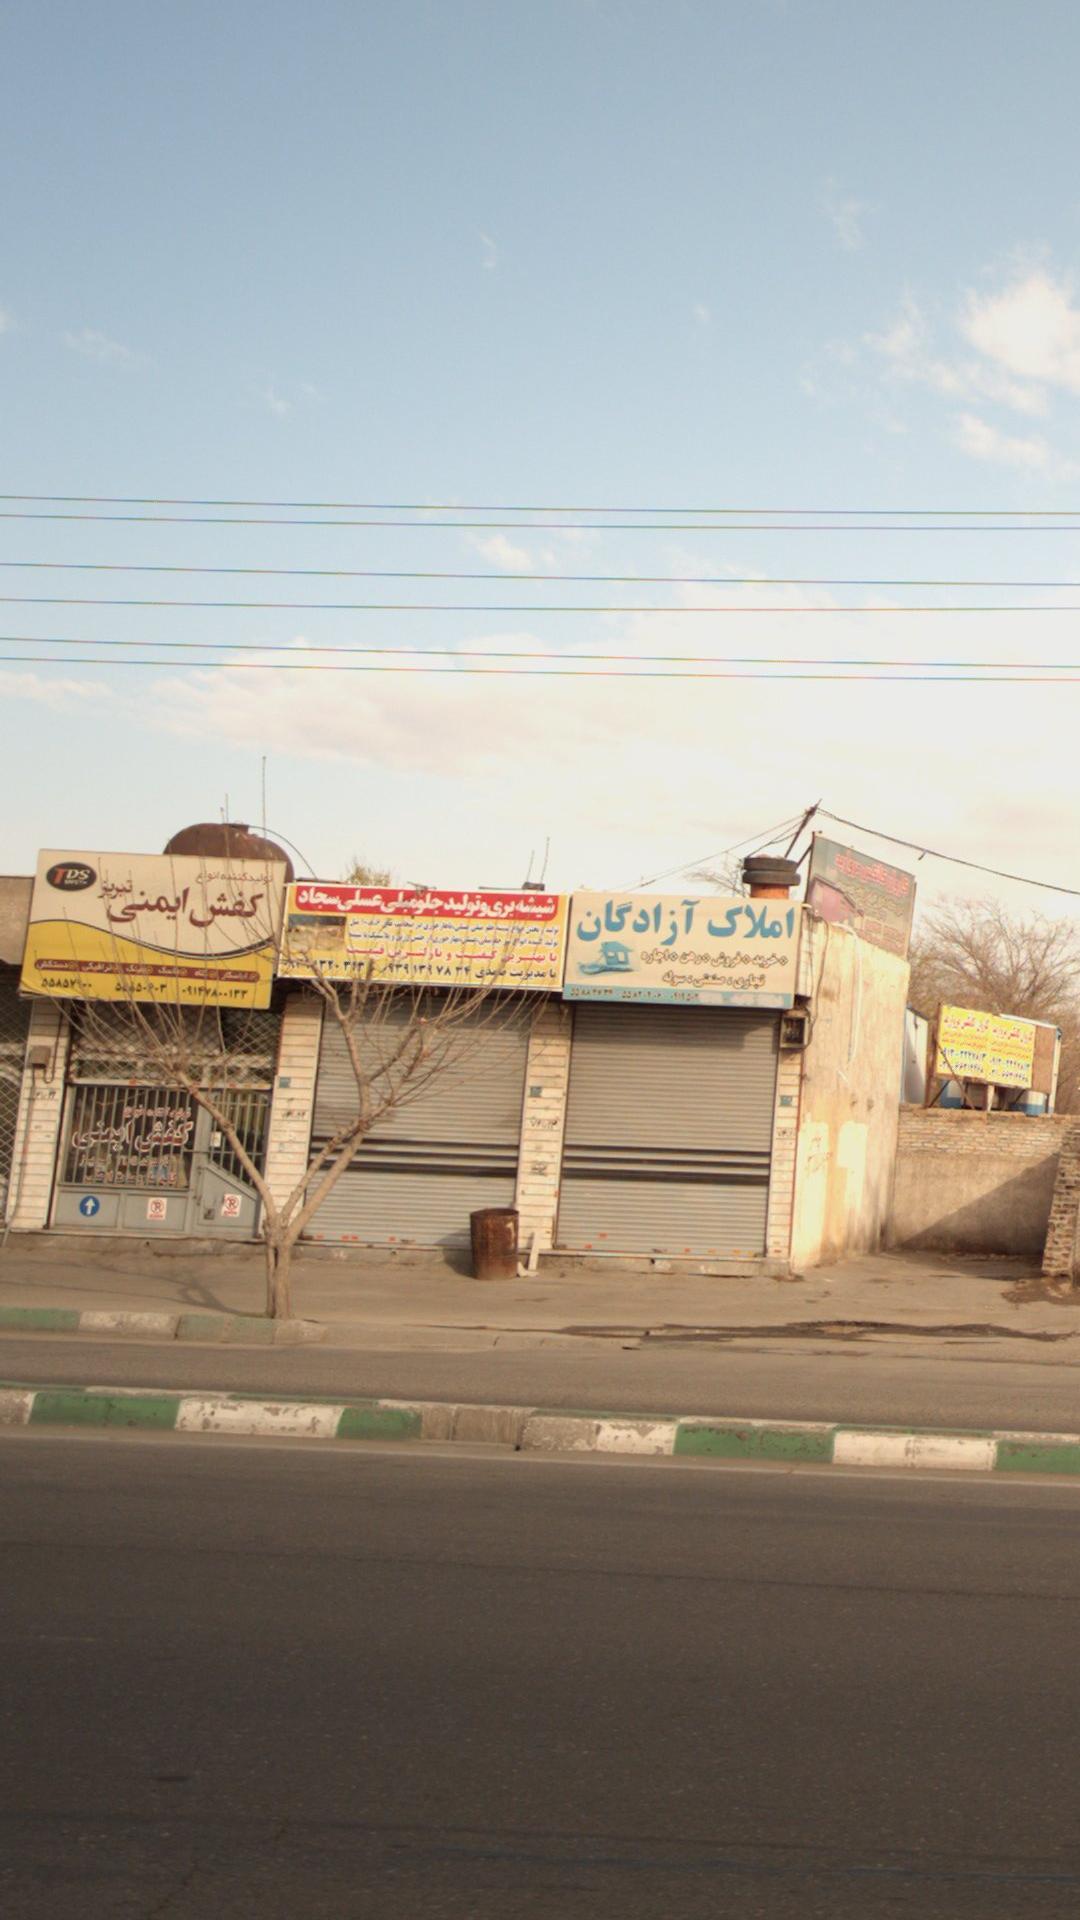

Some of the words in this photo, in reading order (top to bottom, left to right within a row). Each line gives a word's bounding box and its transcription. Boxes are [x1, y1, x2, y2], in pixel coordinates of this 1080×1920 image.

[53, 868, 91, 884] TDS
[97, 879, 133, 899] تبریز
[298, 887, 340, 909] سجاد
[337, 889, 383, 911] عسلی
[107, 887, 190, 922] ایمنی
[189, 892, 264, 927] کفش
[576, 899, 700, 946] آزادگان
[707, 905, 795, 939] املاک
[680, 950, 705, 965] رهن
[710, 951, 742, 968] فروش
[752, 953, 779, 968] خرید
[72, 1120, 136, 1151] ایمنی
[135, 1120, 193, 1151] کفش
